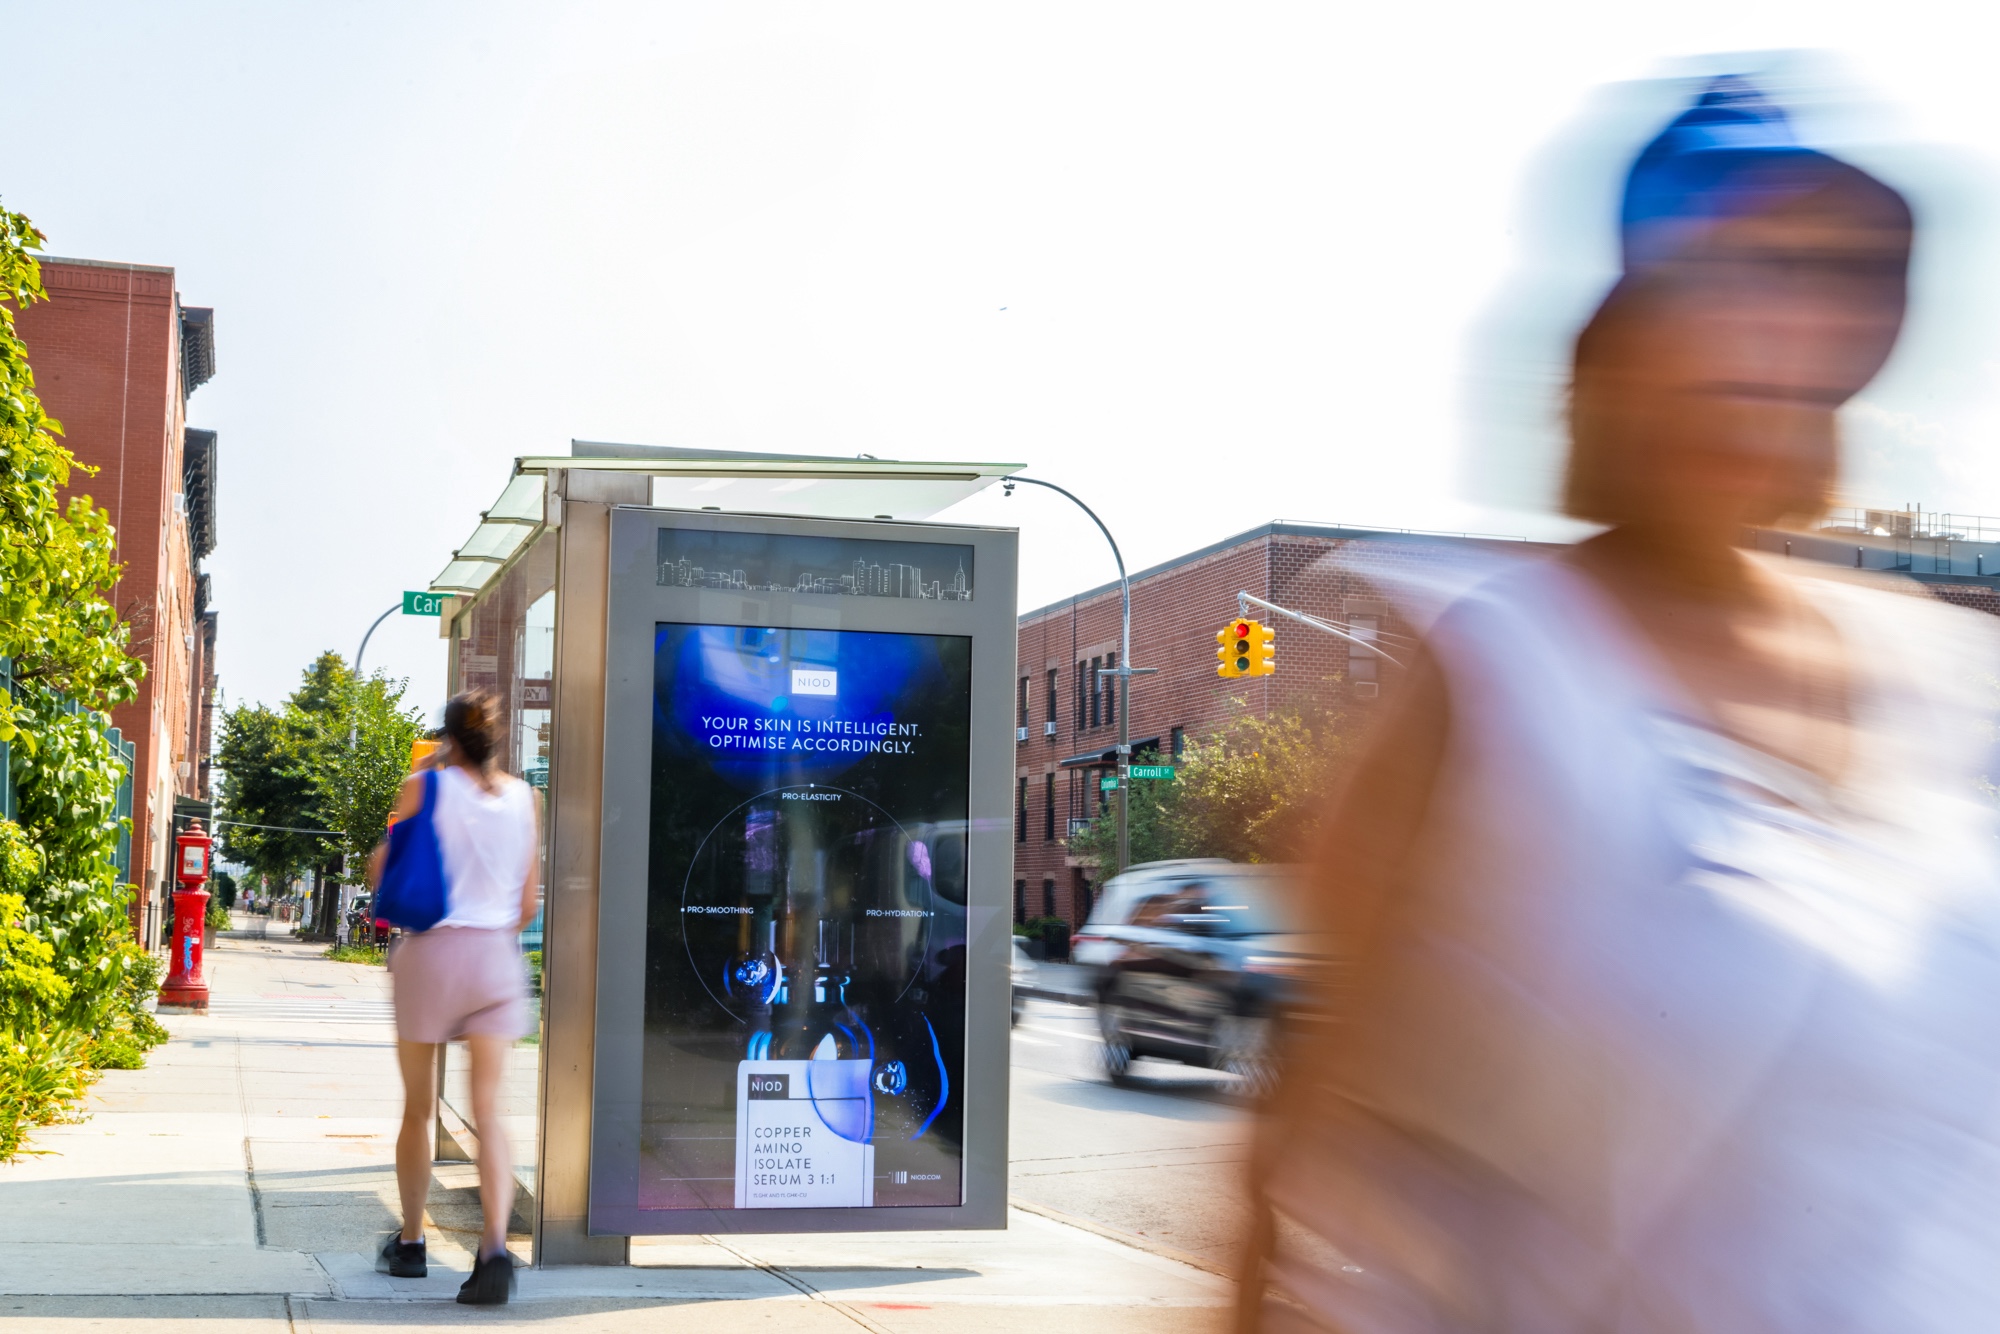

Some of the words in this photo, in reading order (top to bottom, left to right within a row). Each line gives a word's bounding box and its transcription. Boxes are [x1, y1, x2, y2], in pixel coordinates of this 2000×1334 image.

[798, 678, 831, 688] NIOD
[701, 716, 748, 731] YOUR
[754, 718, 791, 732] SKIN
[798, 719, 811, 733] IS
[817, 720, 923, 737] INTELLIGENT.
[709, 734, 787, 750] OPTIMISE
[791, 737, 915, 754] ACCORDINGLY.
[1133, 767, 1162, 777] Carroll
[781, 792, 842, 801] PRO-ELASTICITY
[687, 906, 754, 915] PRO-SMOOTHING
[866, 909, 929, 918] PRO-HYDRATION
[751, 1081, 783, 1092] NIOD
[754, 1126, 812, 1138] COPPER
[754, 1142, 803, 1154] AMINO
[754, 1158, 812, 1170] ISOLATE
[753, 1174, 802, 1186] SERUM
[807, 1174, 815, 1185] 3
[820, 1173, 836, 1185] 1:1
